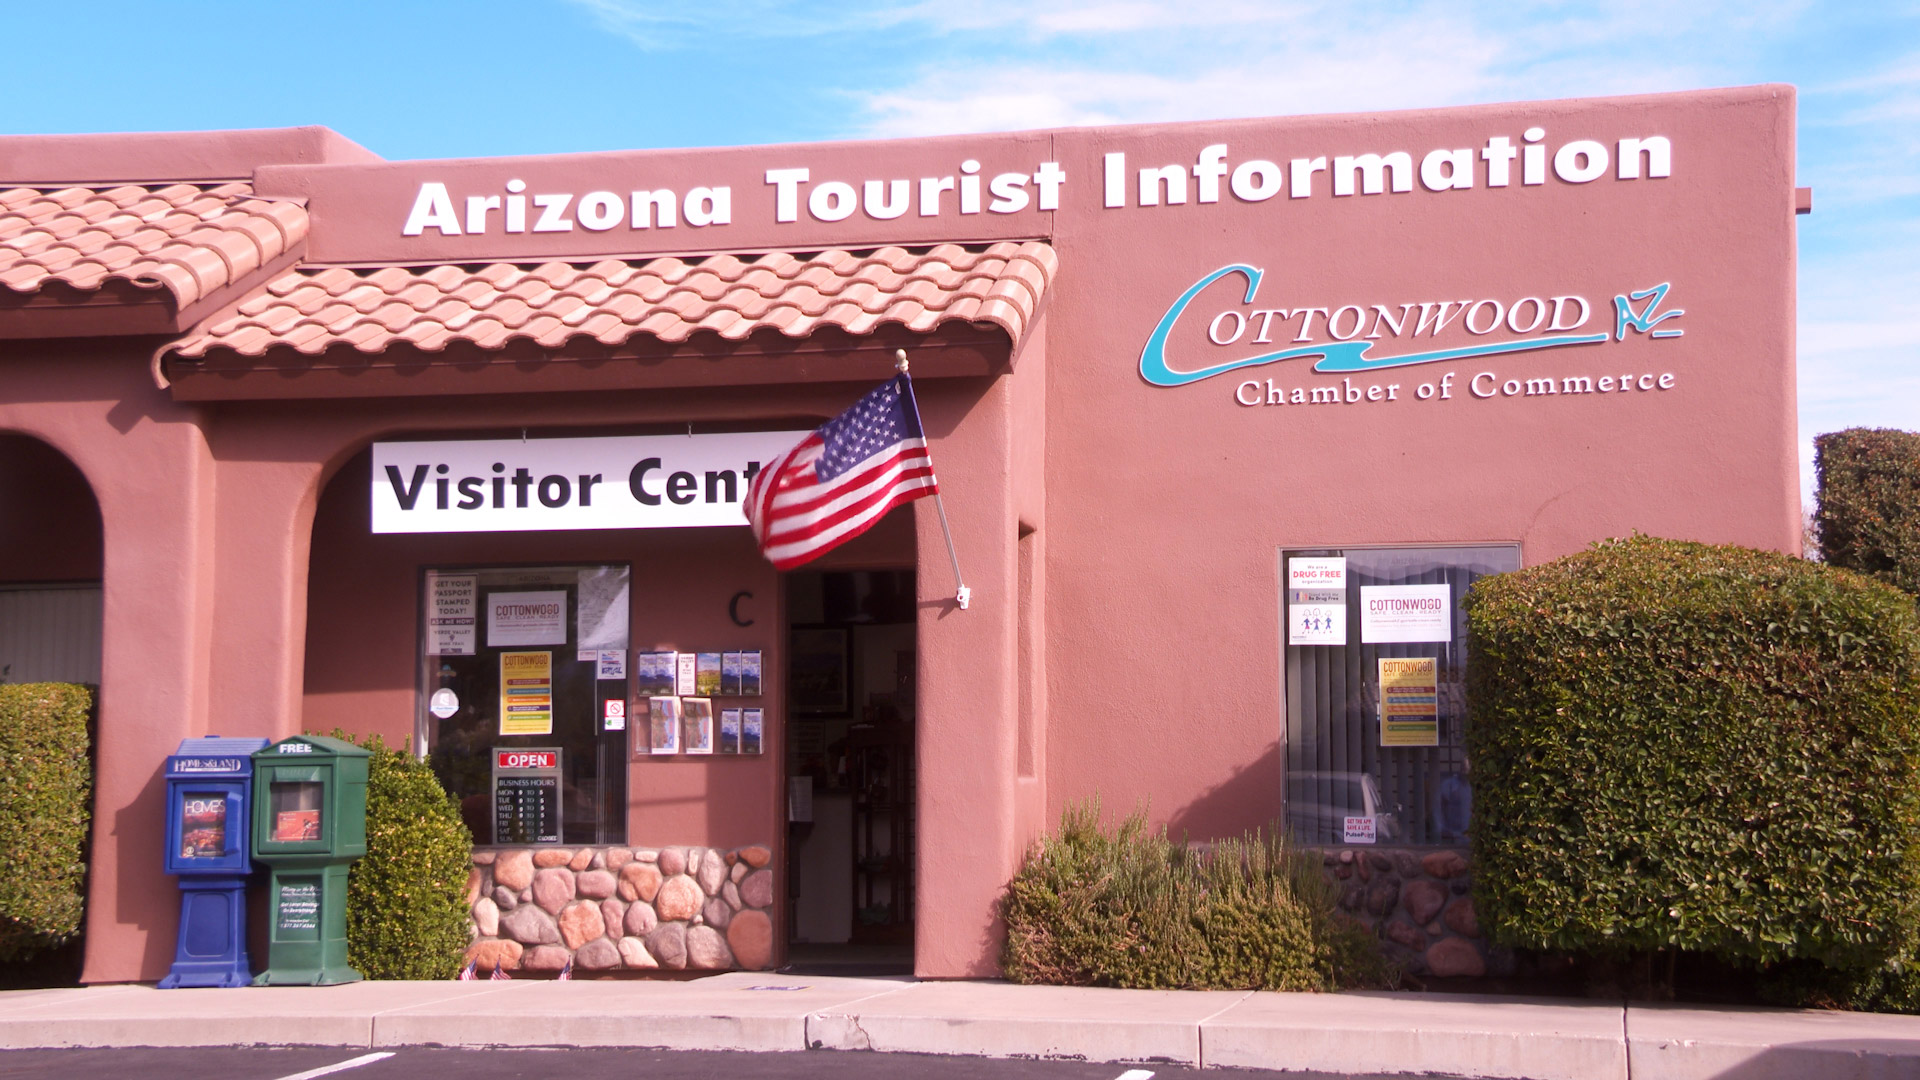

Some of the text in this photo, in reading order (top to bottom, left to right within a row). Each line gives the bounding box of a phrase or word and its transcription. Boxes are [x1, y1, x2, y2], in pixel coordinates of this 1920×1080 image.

[403, 126, 1671, 236] Arizona Tourist Information
[1140, 263, 1686, 387] COTTONWOOD AZ
[1236, 364, 1676, 406] Chamber of Commerce
[384, 462, 602, 511] Visitor
[1293, 570, 1341, 578] DRUG FREE
[496, 604, 560, 616] COTTONWOOD
[729, 591, 754, 627] C
[1370, 598, 1442, 611] COTTONWOOD
[504, 655, 548, 666] COTTONWOOD
[1384, 661, 1432, 672] COTTONWOOD
[280, 743, 312, 754] FREE
[508, 754, 547, 766] OPEN
[185, 799, 225, 813] HOMES
